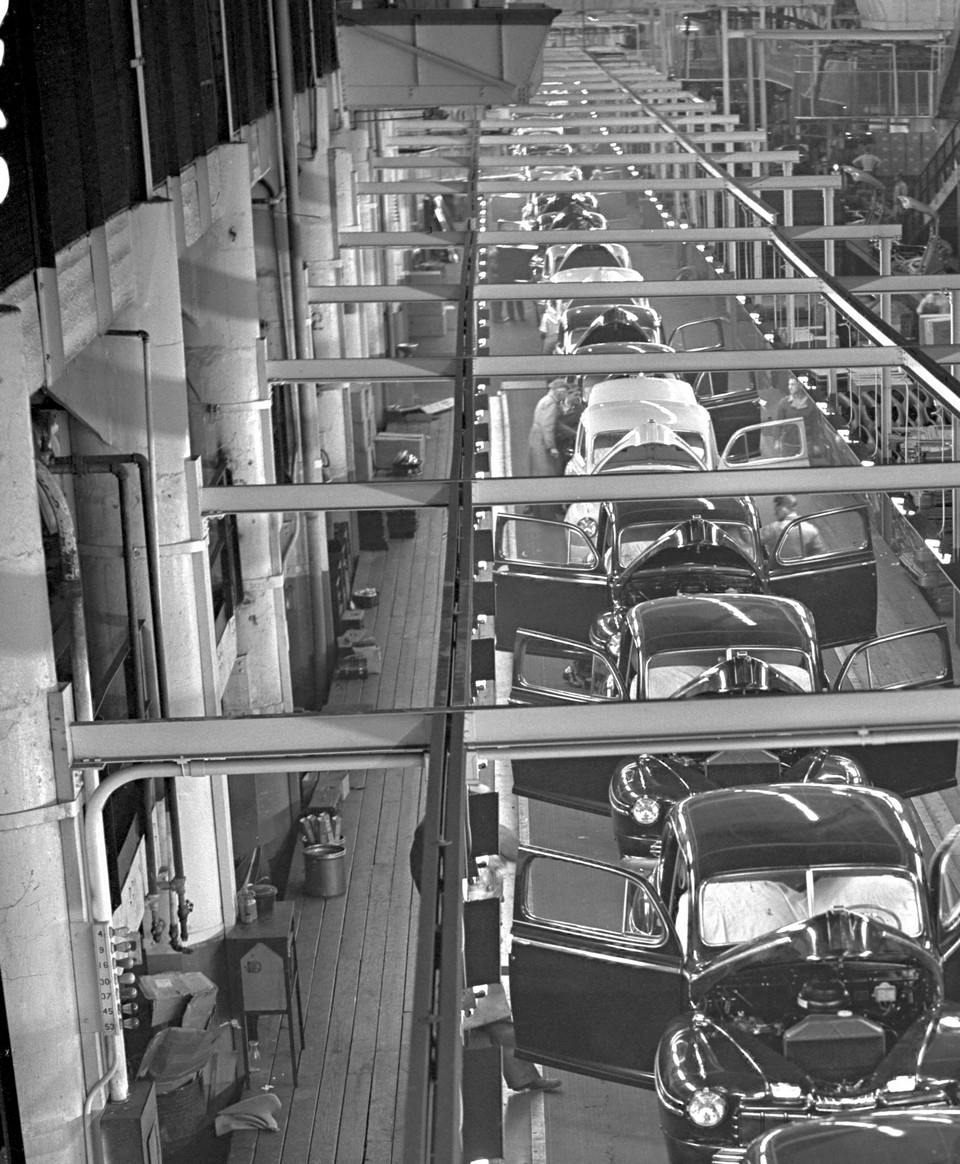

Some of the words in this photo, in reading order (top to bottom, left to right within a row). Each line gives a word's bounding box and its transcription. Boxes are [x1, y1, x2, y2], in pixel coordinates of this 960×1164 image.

[97, 930, 103, 938] 4
[98, 961, 109, 969] 16
[99, 978, 111, 986] 30
[100, 992, 112, 1000] 37
[102, 1007, 114, 1015] 45
[104, 1022, 115, 1030] 53
